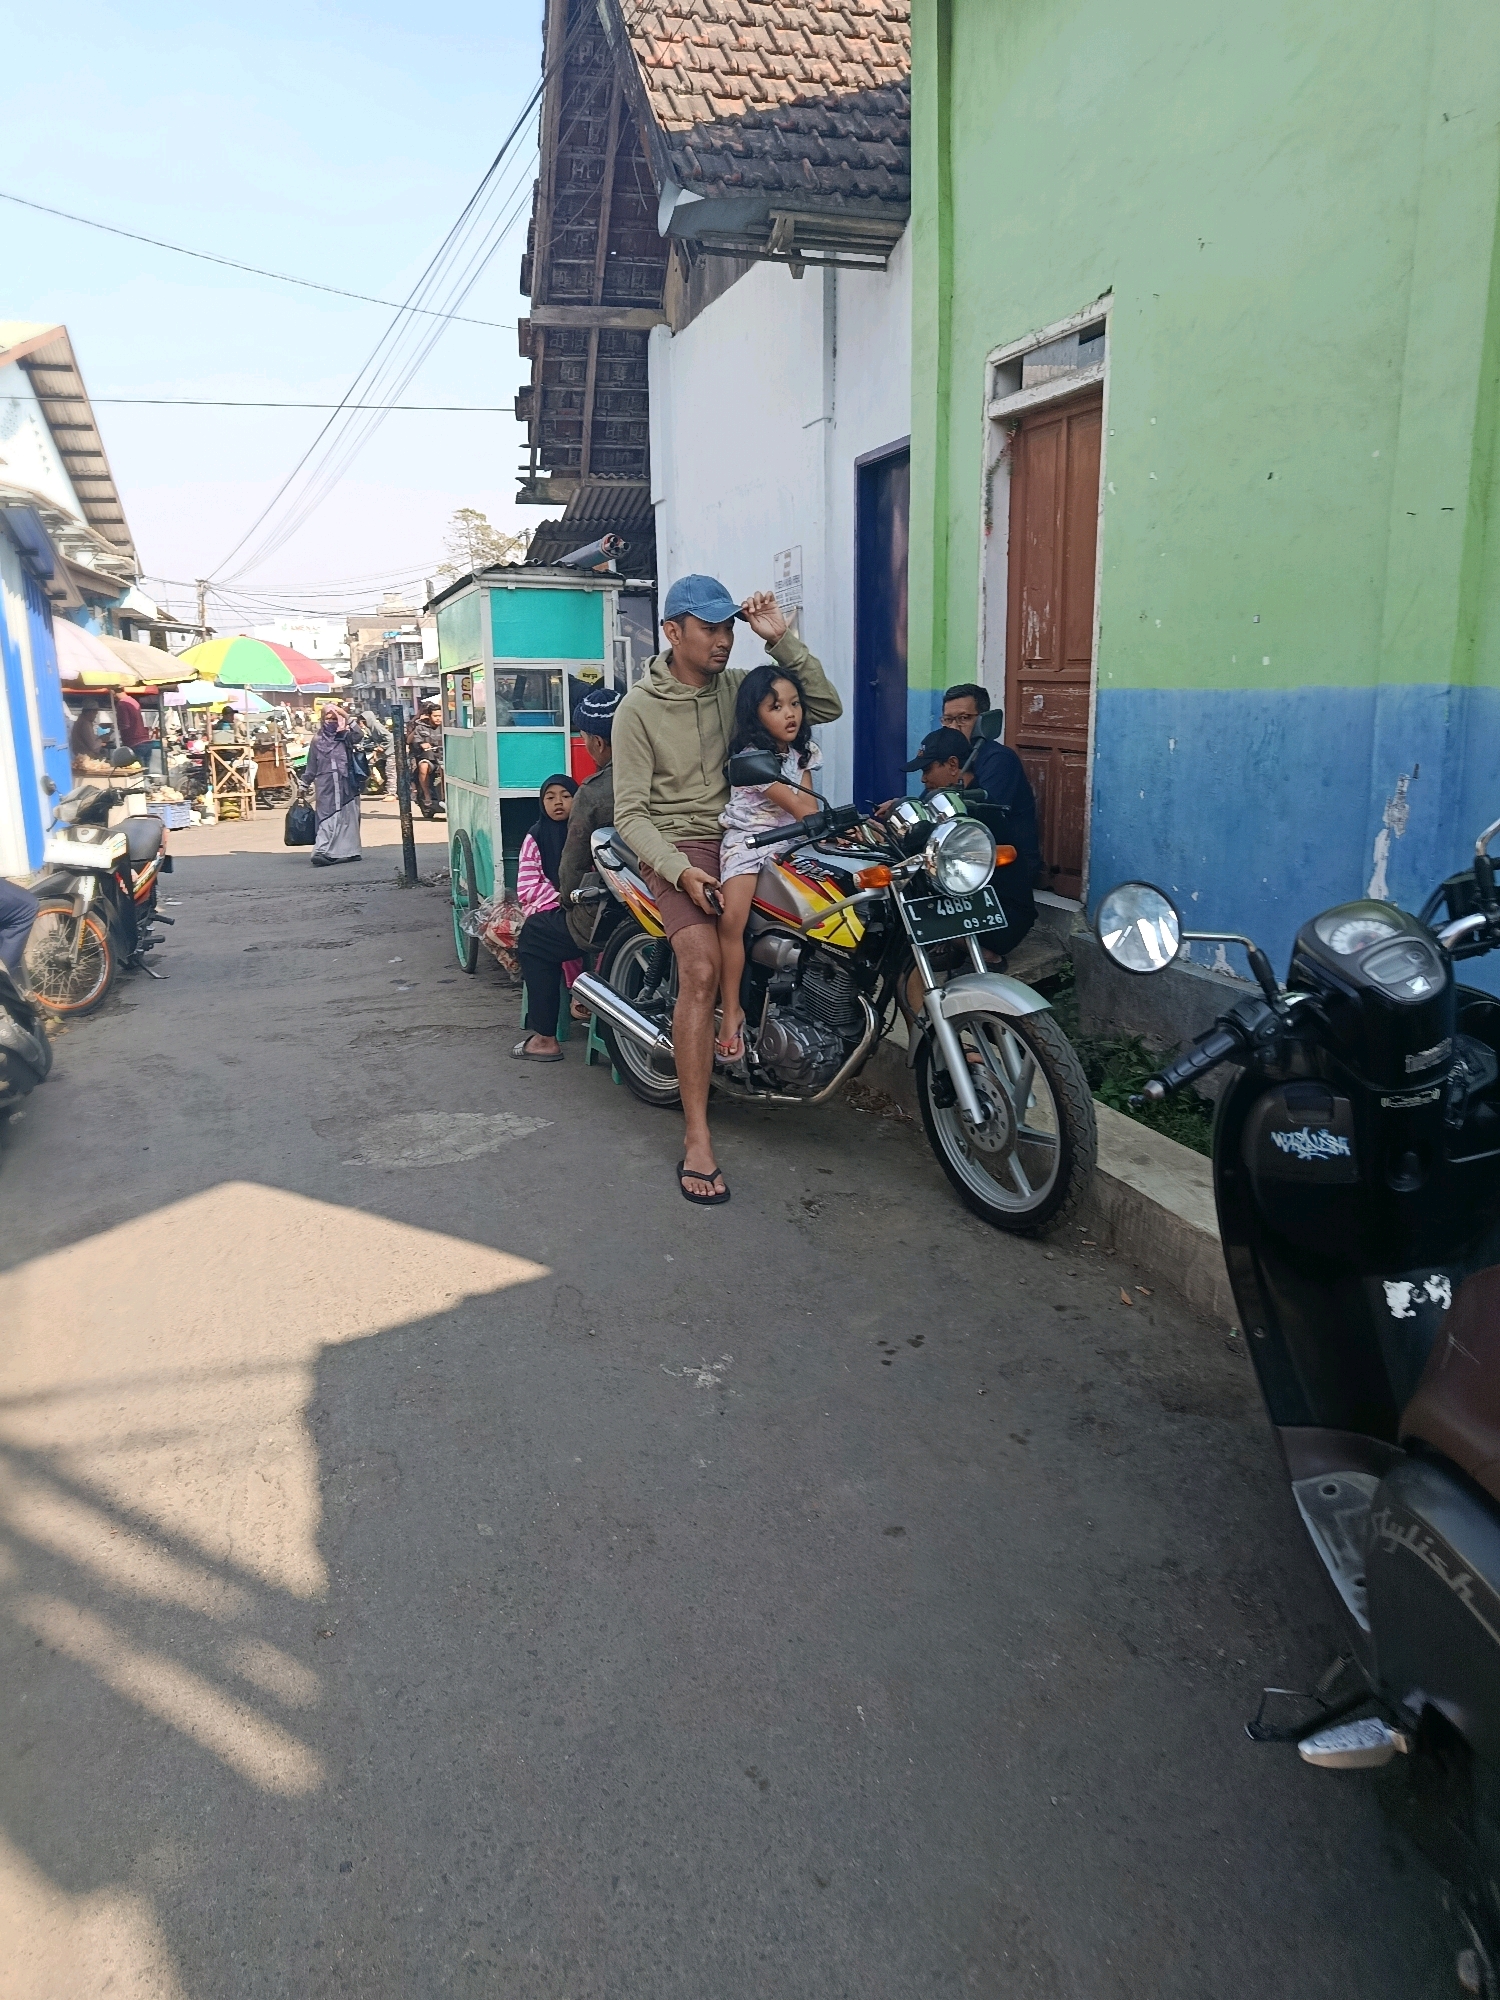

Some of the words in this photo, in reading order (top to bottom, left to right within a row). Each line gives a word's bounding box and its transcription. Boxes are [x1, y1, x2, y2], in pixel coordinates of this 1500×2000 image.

[907, 904, 922, 922] L
[936, 896, 973, 917] 4886
[983, 890, 995, 908] A
[820, 942, 851, 960] HONDA
